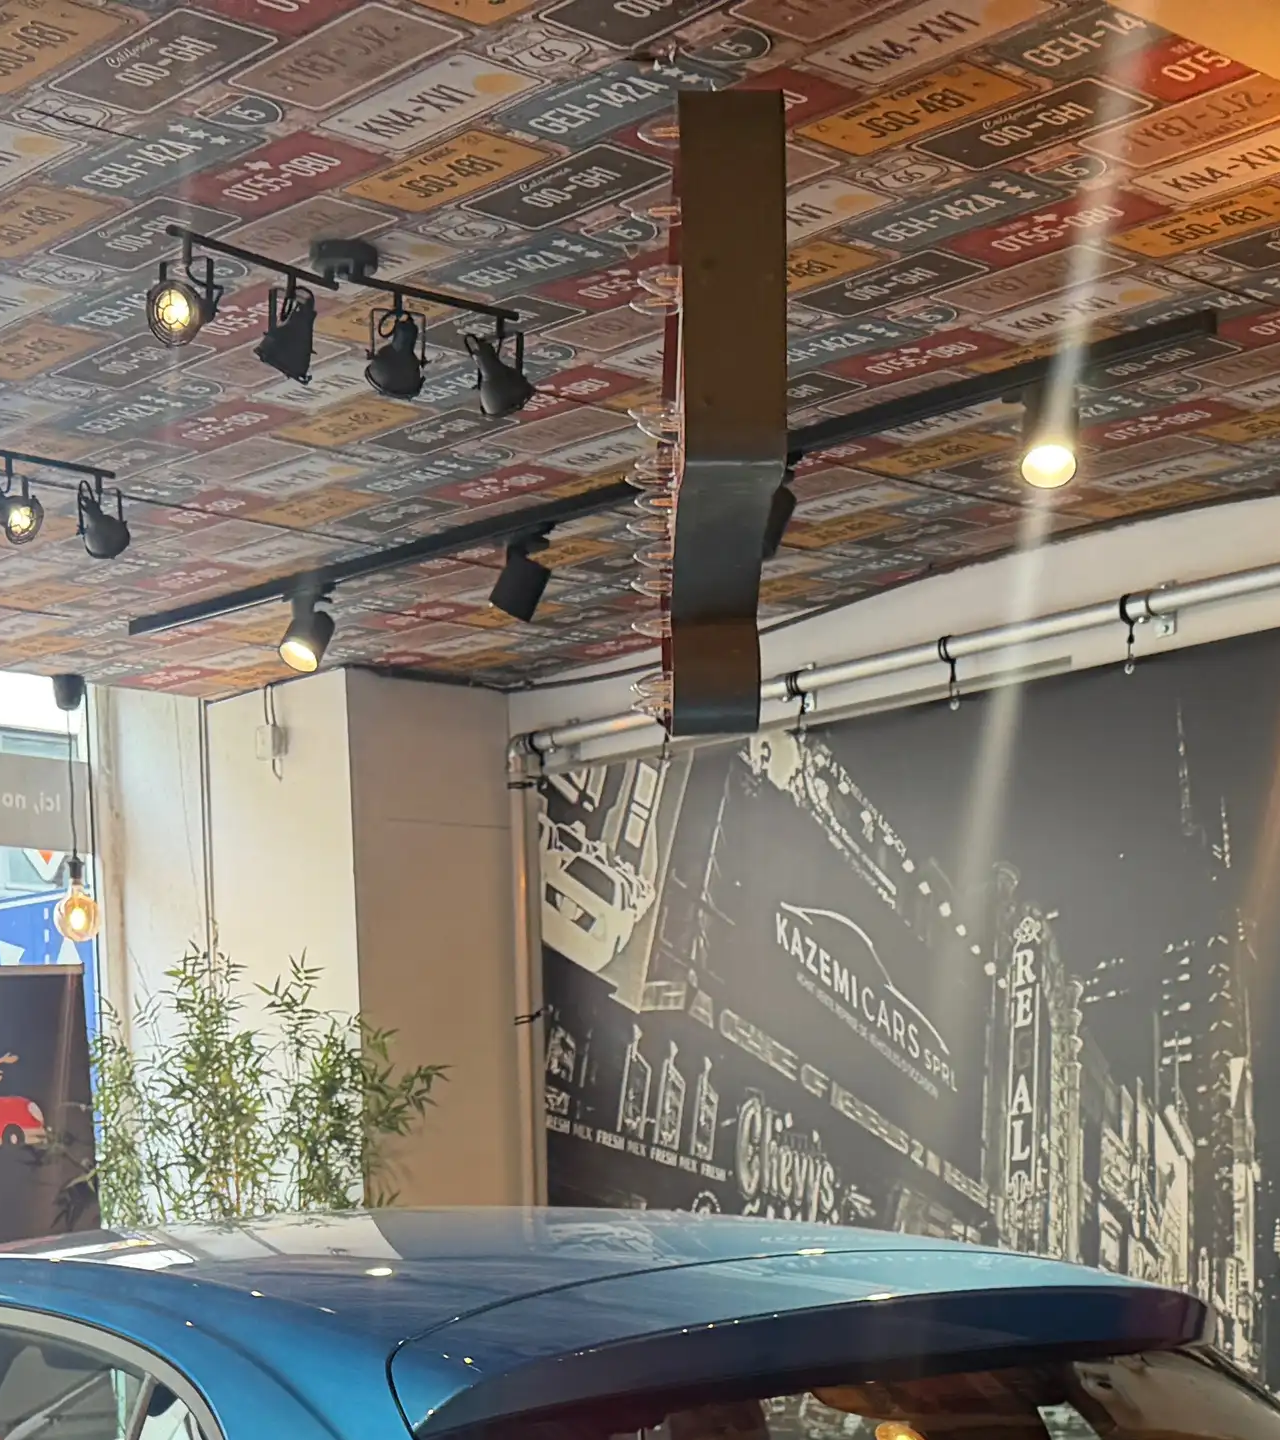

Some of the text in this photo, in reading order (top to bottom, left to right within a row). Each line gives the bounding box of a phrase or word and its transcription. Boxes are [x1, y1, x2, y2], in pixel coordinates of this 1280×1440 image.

[223, 104, 271, 123] 15
[529, 75, 668, 134] GEH-142A
[80, 136, 202, 190] GEH-142A
[872, 194, 1004, 241] GEH-142A
[775, 911, 858, 1010] KAZEMI
[861, 987, 920, 1059] CARS
[924, 1053, 958, 1093] SPRL
